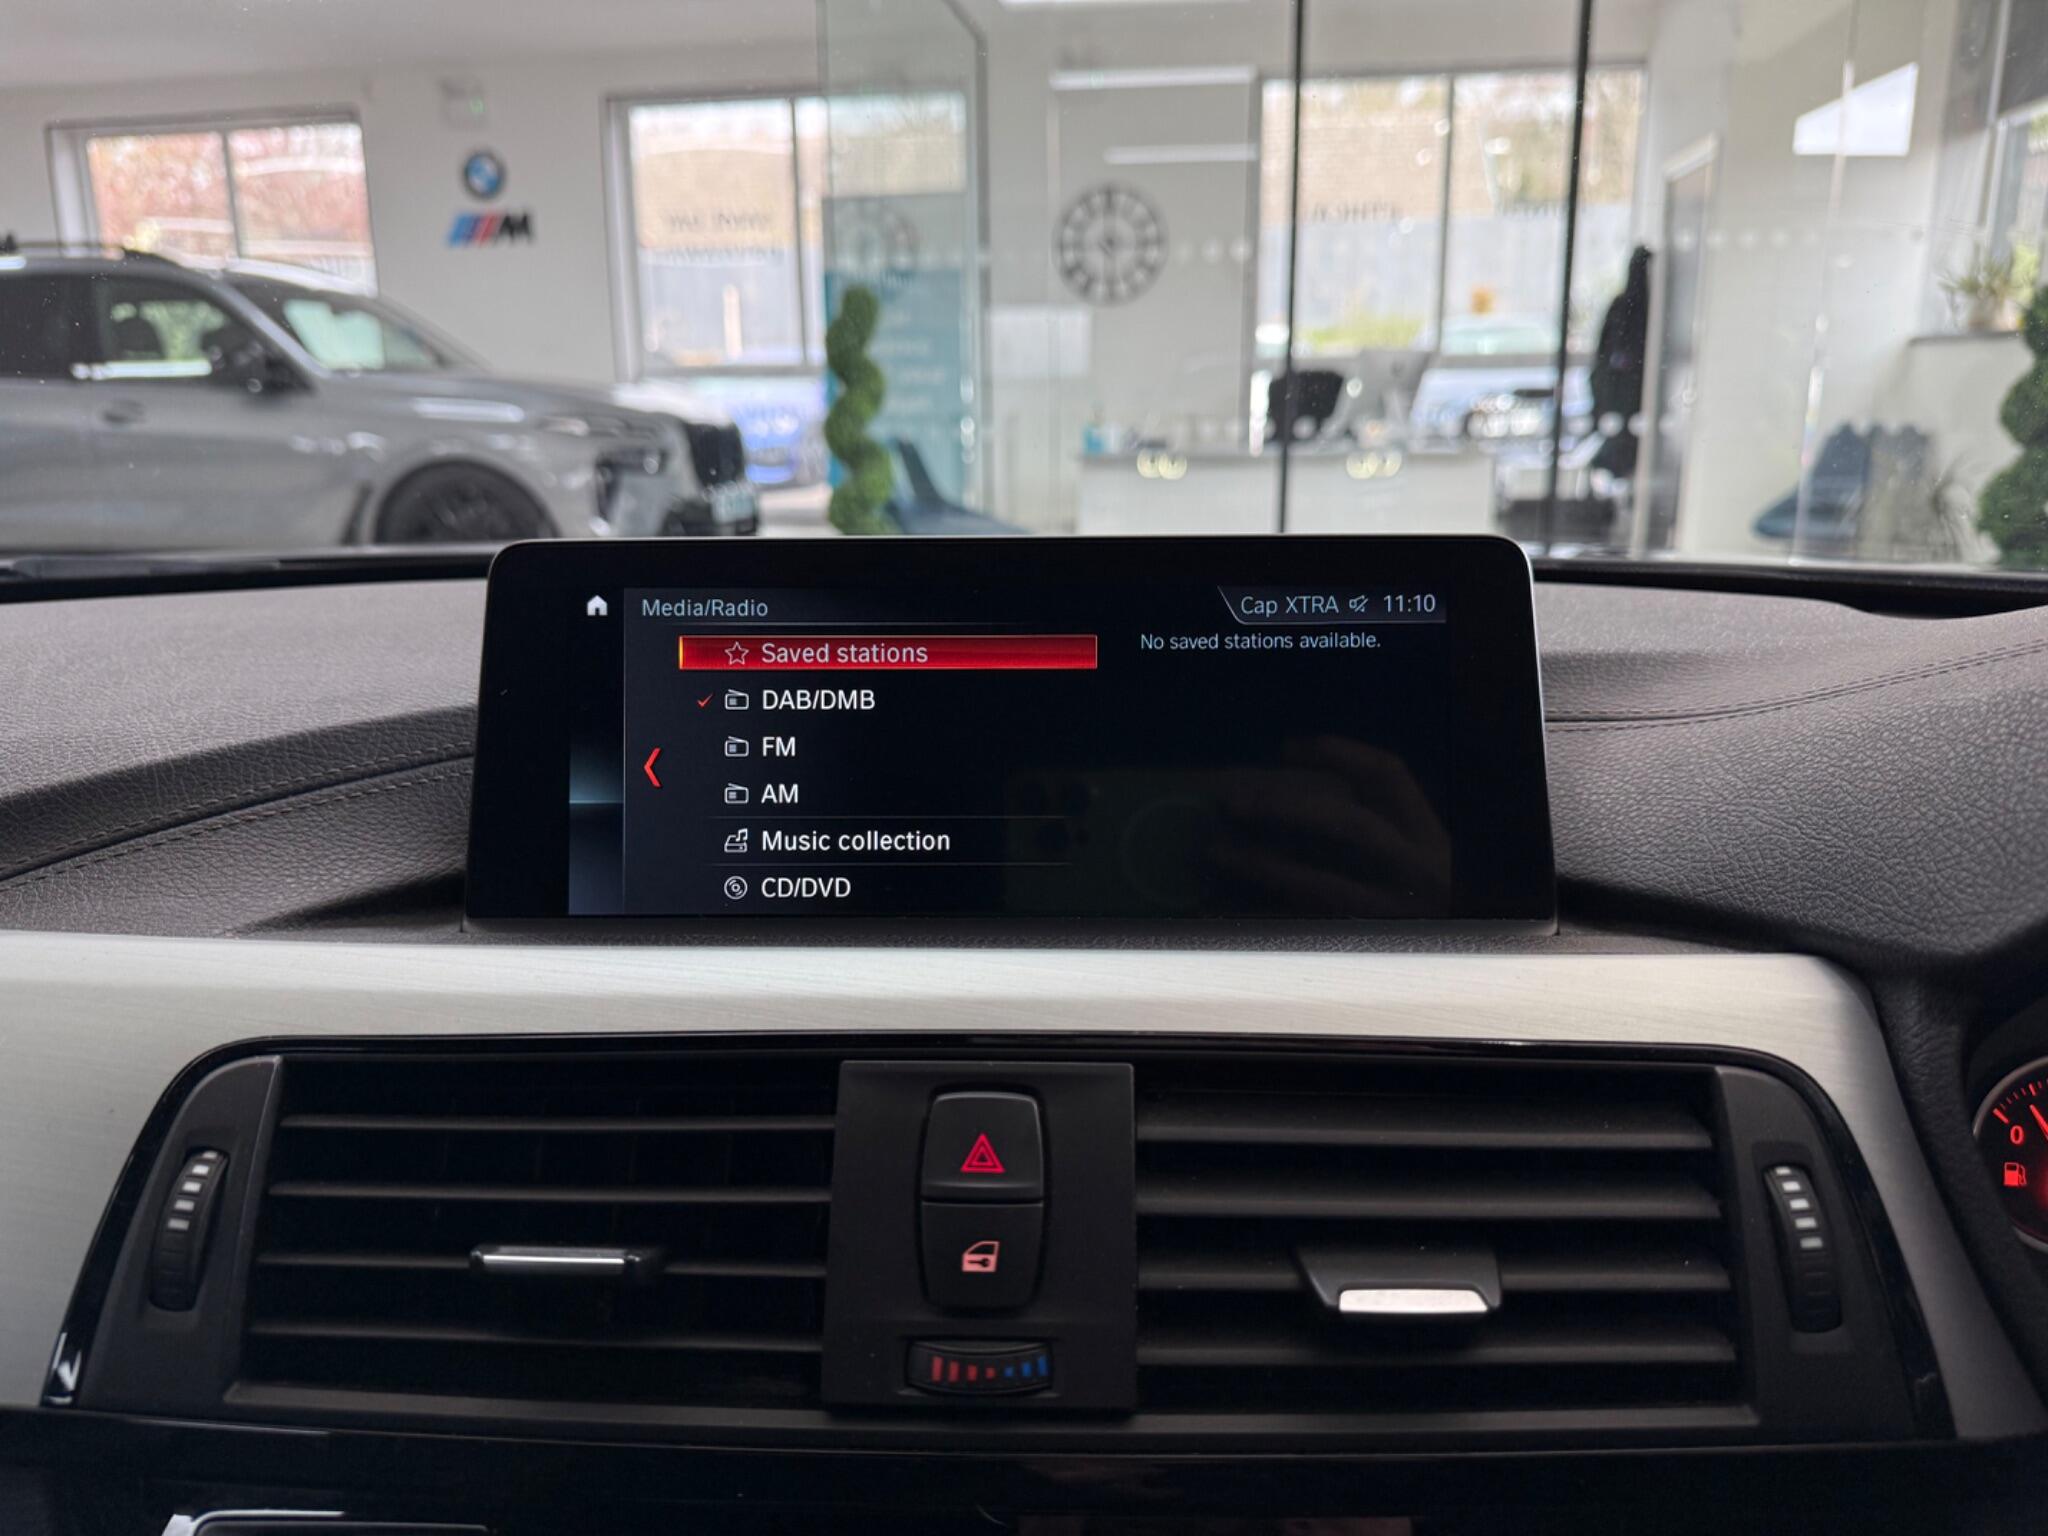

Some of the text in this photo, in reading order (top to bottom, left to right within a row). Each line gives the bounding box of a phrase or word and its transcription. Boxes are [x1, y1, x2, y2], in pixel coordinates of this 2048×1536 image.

[641, 599, 769, 617] Media/Radio
[1240, 596, 1340, 617] Cap XTRA
[1383, 594, 1436, 612] 11:10
[1140, 631, 1381, 649] No saved stations available.
[761, 643, 929, 663] Saved stations
[762, 689, 876, 710] DAB/DMB
[762, 736, 796, 757] FM
[761, 783, 799, 804] AM
[761, 829, 951, 851] Music collection
[761, 877, 852, 898] CD/DVD
[2010, 1125, 2025, 1145] 0
